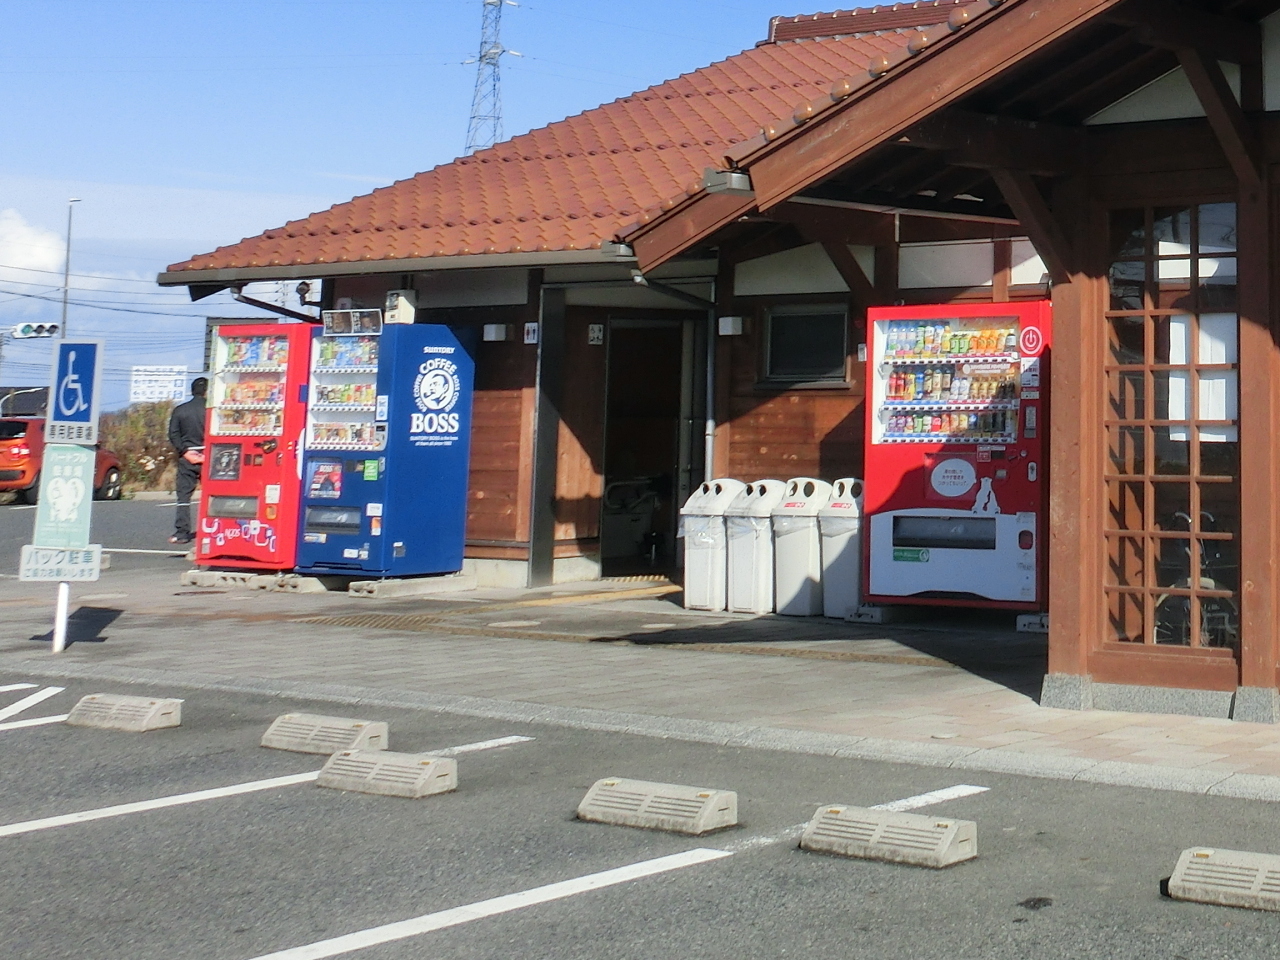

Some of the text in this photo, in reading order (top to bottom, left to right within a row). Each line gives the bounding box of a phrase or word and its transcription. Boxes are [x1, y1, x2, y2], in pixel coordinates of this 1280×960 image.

[423, 346, 455, 354] SUNTORY
[419, 357, 457, 375] COFFEE
[410, 413, 460, 433] BOSS
[49, 424, 93, 440] 専用駐車場
[26, 550, 94, 565] バック駐車
[24, 568, 95, 578] ご協力お願いします
